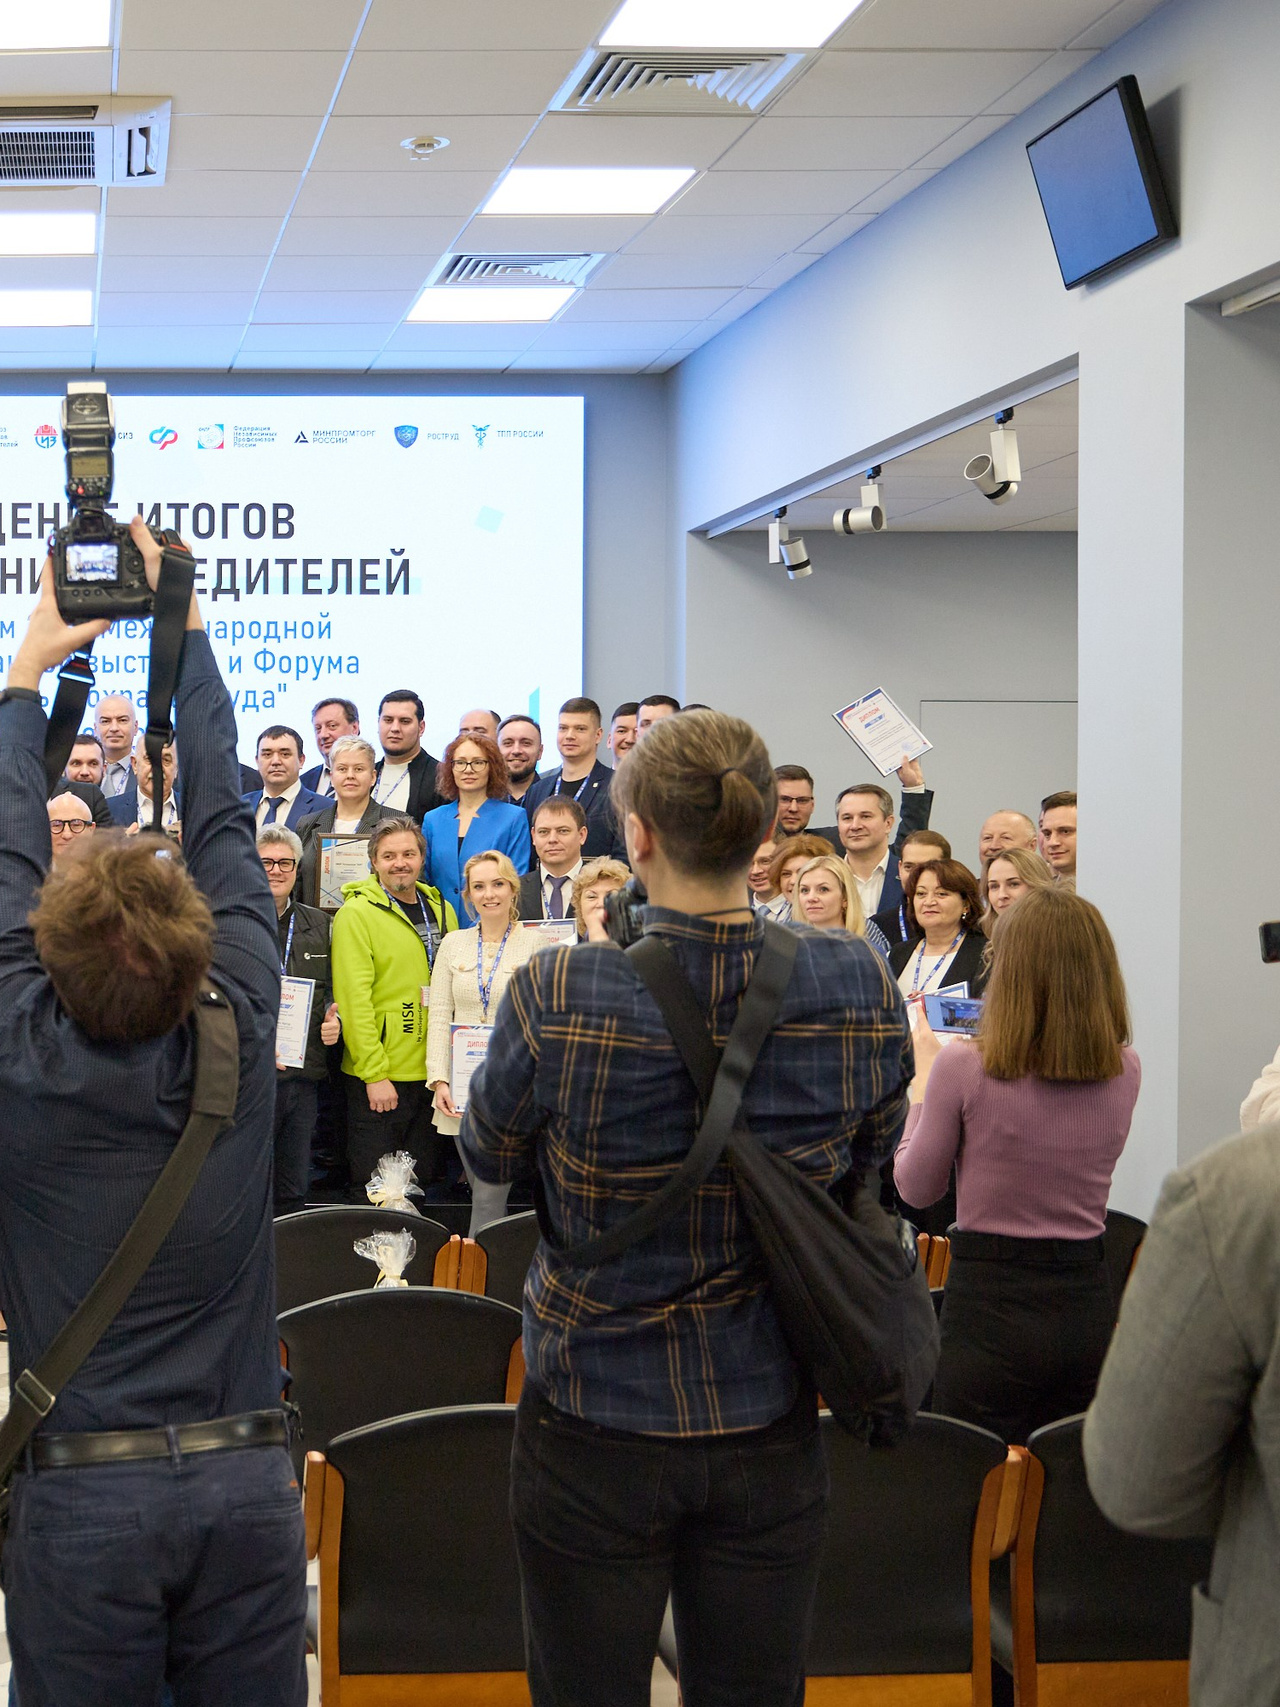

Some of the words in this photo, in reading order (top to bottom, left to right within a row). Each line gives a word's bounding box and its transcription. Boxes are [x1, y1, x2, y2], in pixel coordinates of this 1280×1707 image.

[427, 433, 460, 441] РОСТРУД
[512, 430, 544, 438] РОССИИ
[194, 548, 410, 602] ЕДИТЕЛЕЙ
[228, 655, 242, 673] и
[254, 648, 360, 681] Форума
[402, 1002, 414, 1034] MISK
